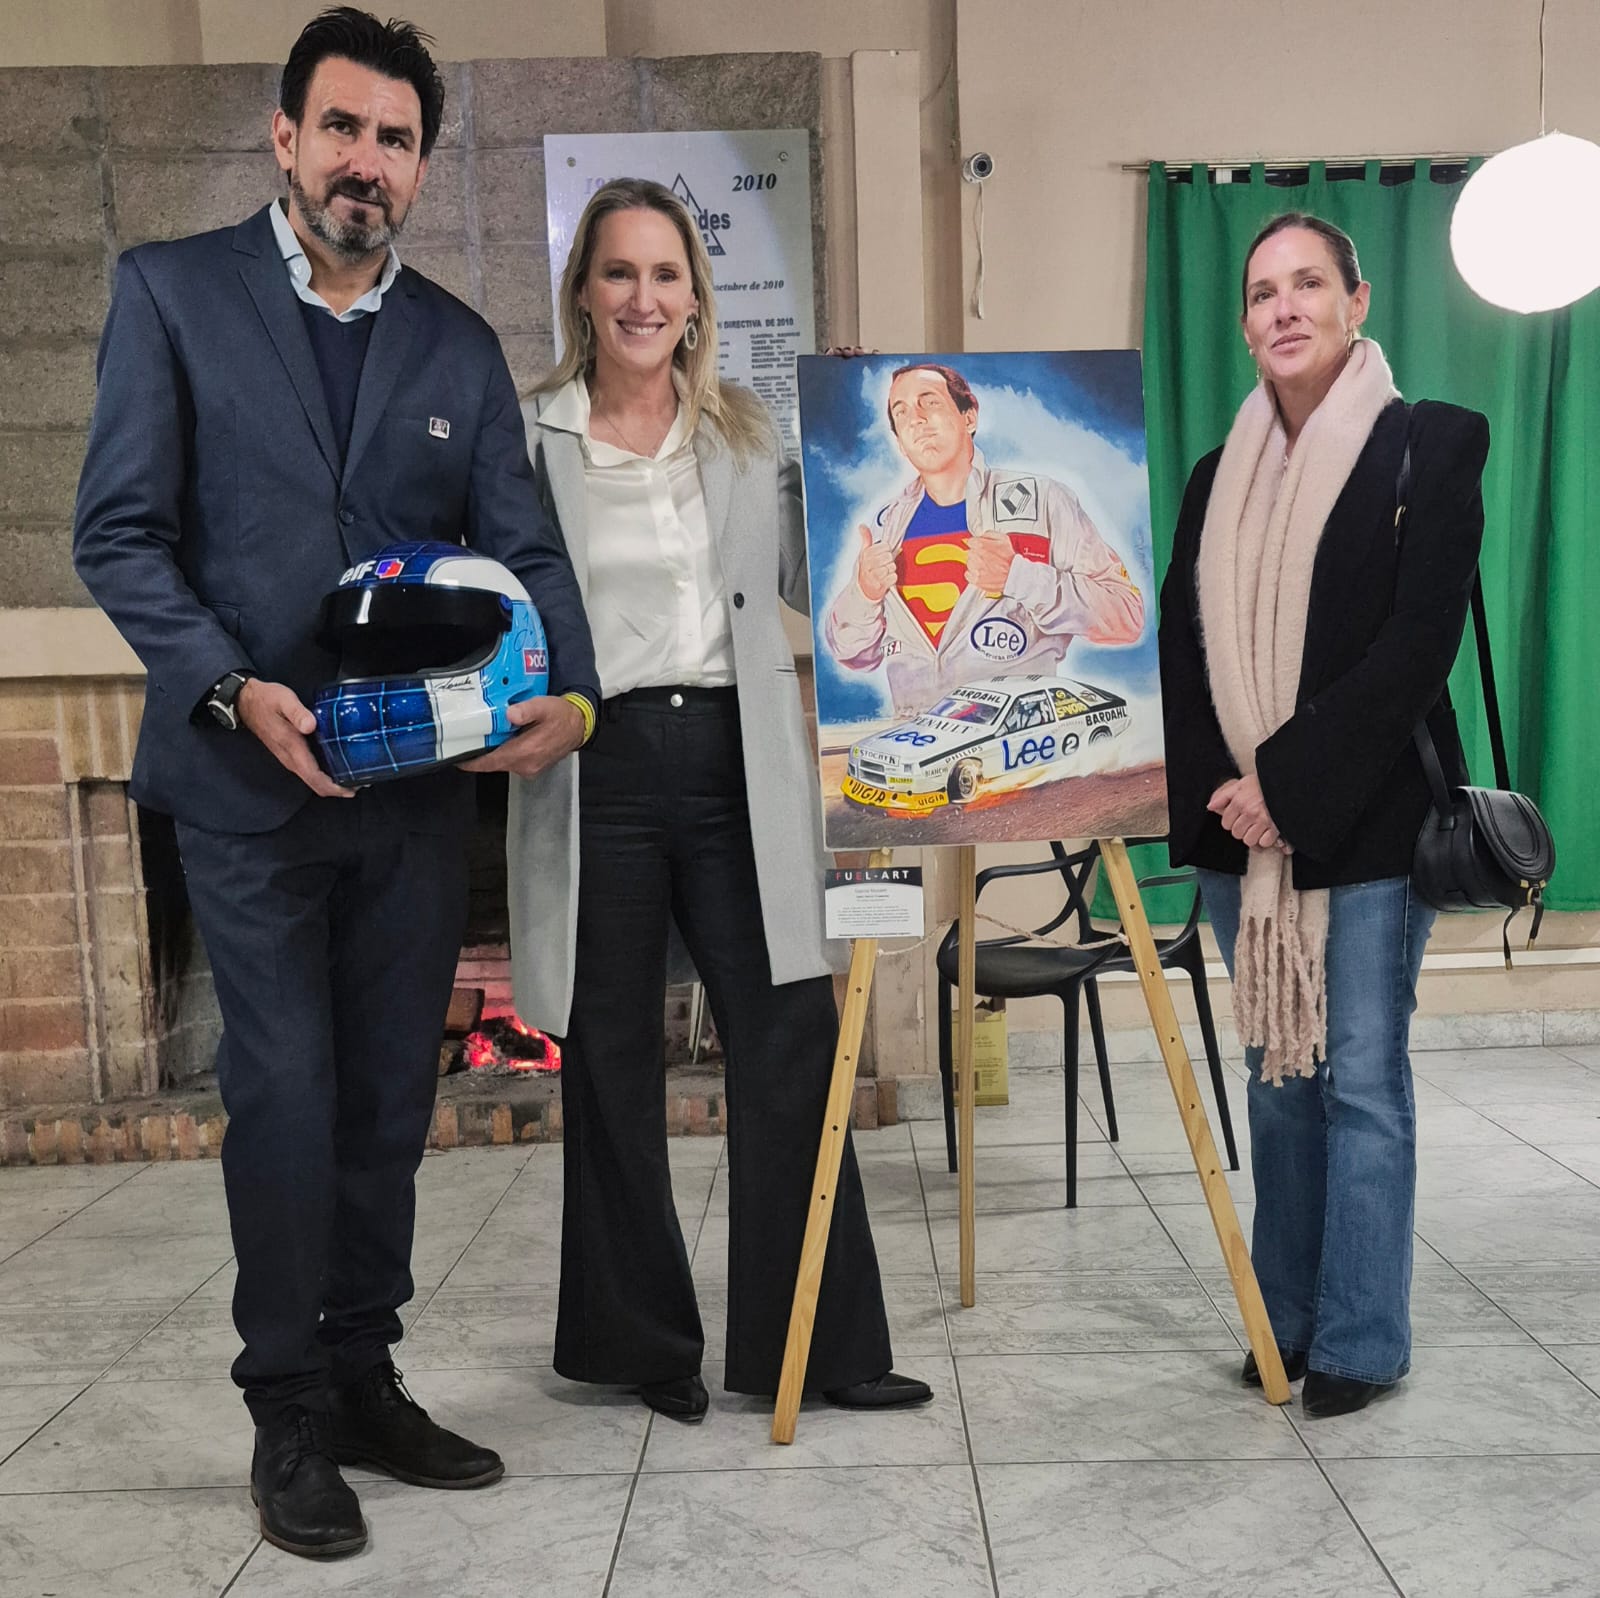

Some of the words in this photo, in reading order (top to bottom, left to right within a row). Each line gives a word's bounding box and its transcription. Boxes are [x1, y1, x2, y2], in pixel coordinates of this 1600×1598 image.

[732, 173, 777, 192] 2010
[692, 208, 732, 230] des
[749, 281, 761, 290] de
[762, 279, 785, 290] 2010
[723, 319, 762, 329] DIRECTIVA
[765, 318, 775, 327] DE
[776, 317, 794, 327] 2010
[338, 560, 377, 586] elf
[982, 625, 1020, 652] Lee
[952, 689, 1002, 704] BARDAHL
[1085, 706, 1128, 727] BARDAHL
[879, 728, 937, 747] Lee
[1002, 736, 1056, 771] Lee
